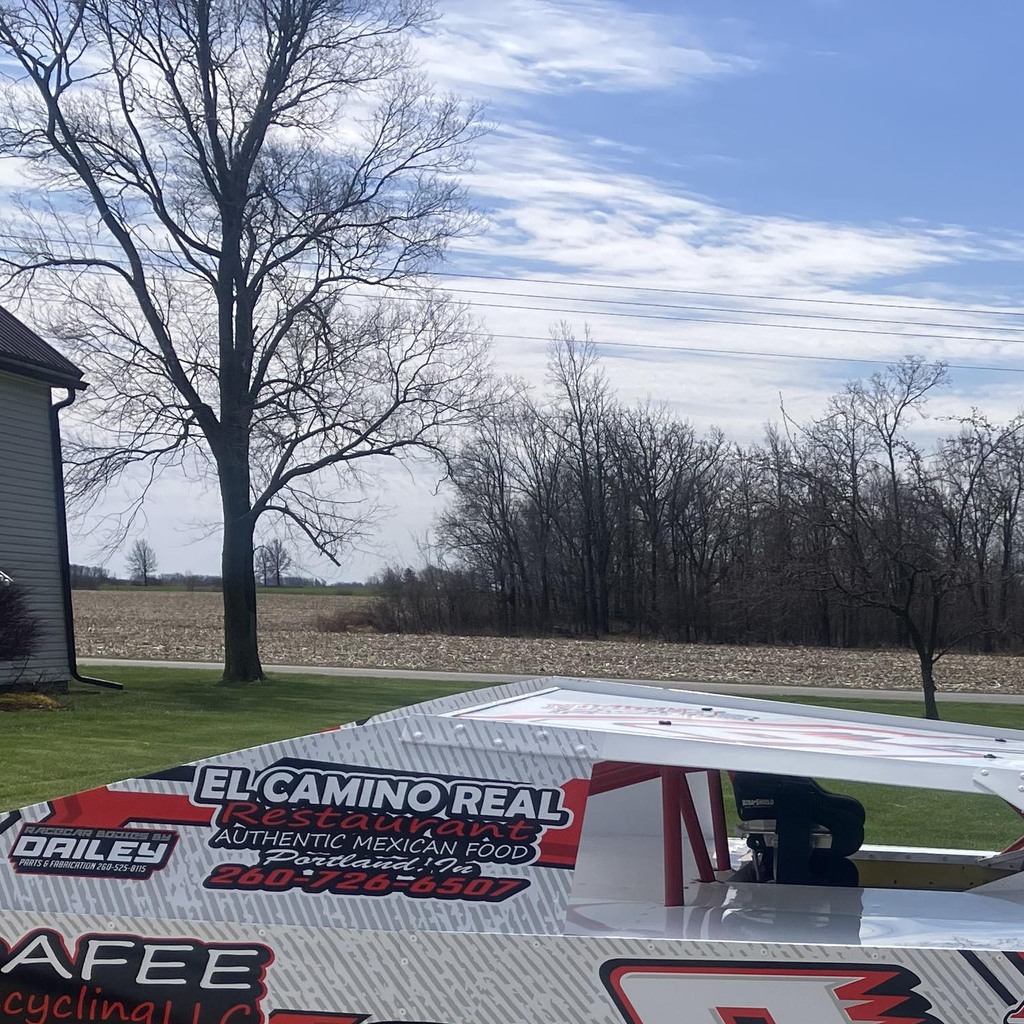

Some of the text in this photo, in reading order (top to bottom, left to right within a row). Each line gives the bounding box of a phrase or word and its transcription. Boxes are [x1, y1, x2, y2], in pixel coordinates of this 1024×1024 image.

[201, 768, 562, 821] EL CAMINO REAL
[24, 826, 172, 842] RACECAR BODIES BY
[221, 801, 535, 841] Restaurant
[12, 836, 168, 864] DAILEY
[214, 828, 528, 860] AUTHENTIC MEXICAN FOOD
[18, 858, 42, 868] PARTS
[50, 861, 96, 871] FABRICATION
[96, 864, 147, 873] 260-525-8115
[434, 857, 474, 874] In
[209, 866, 522, 897] 260-726-6507
[0, 934, 259, 990] AFEE
